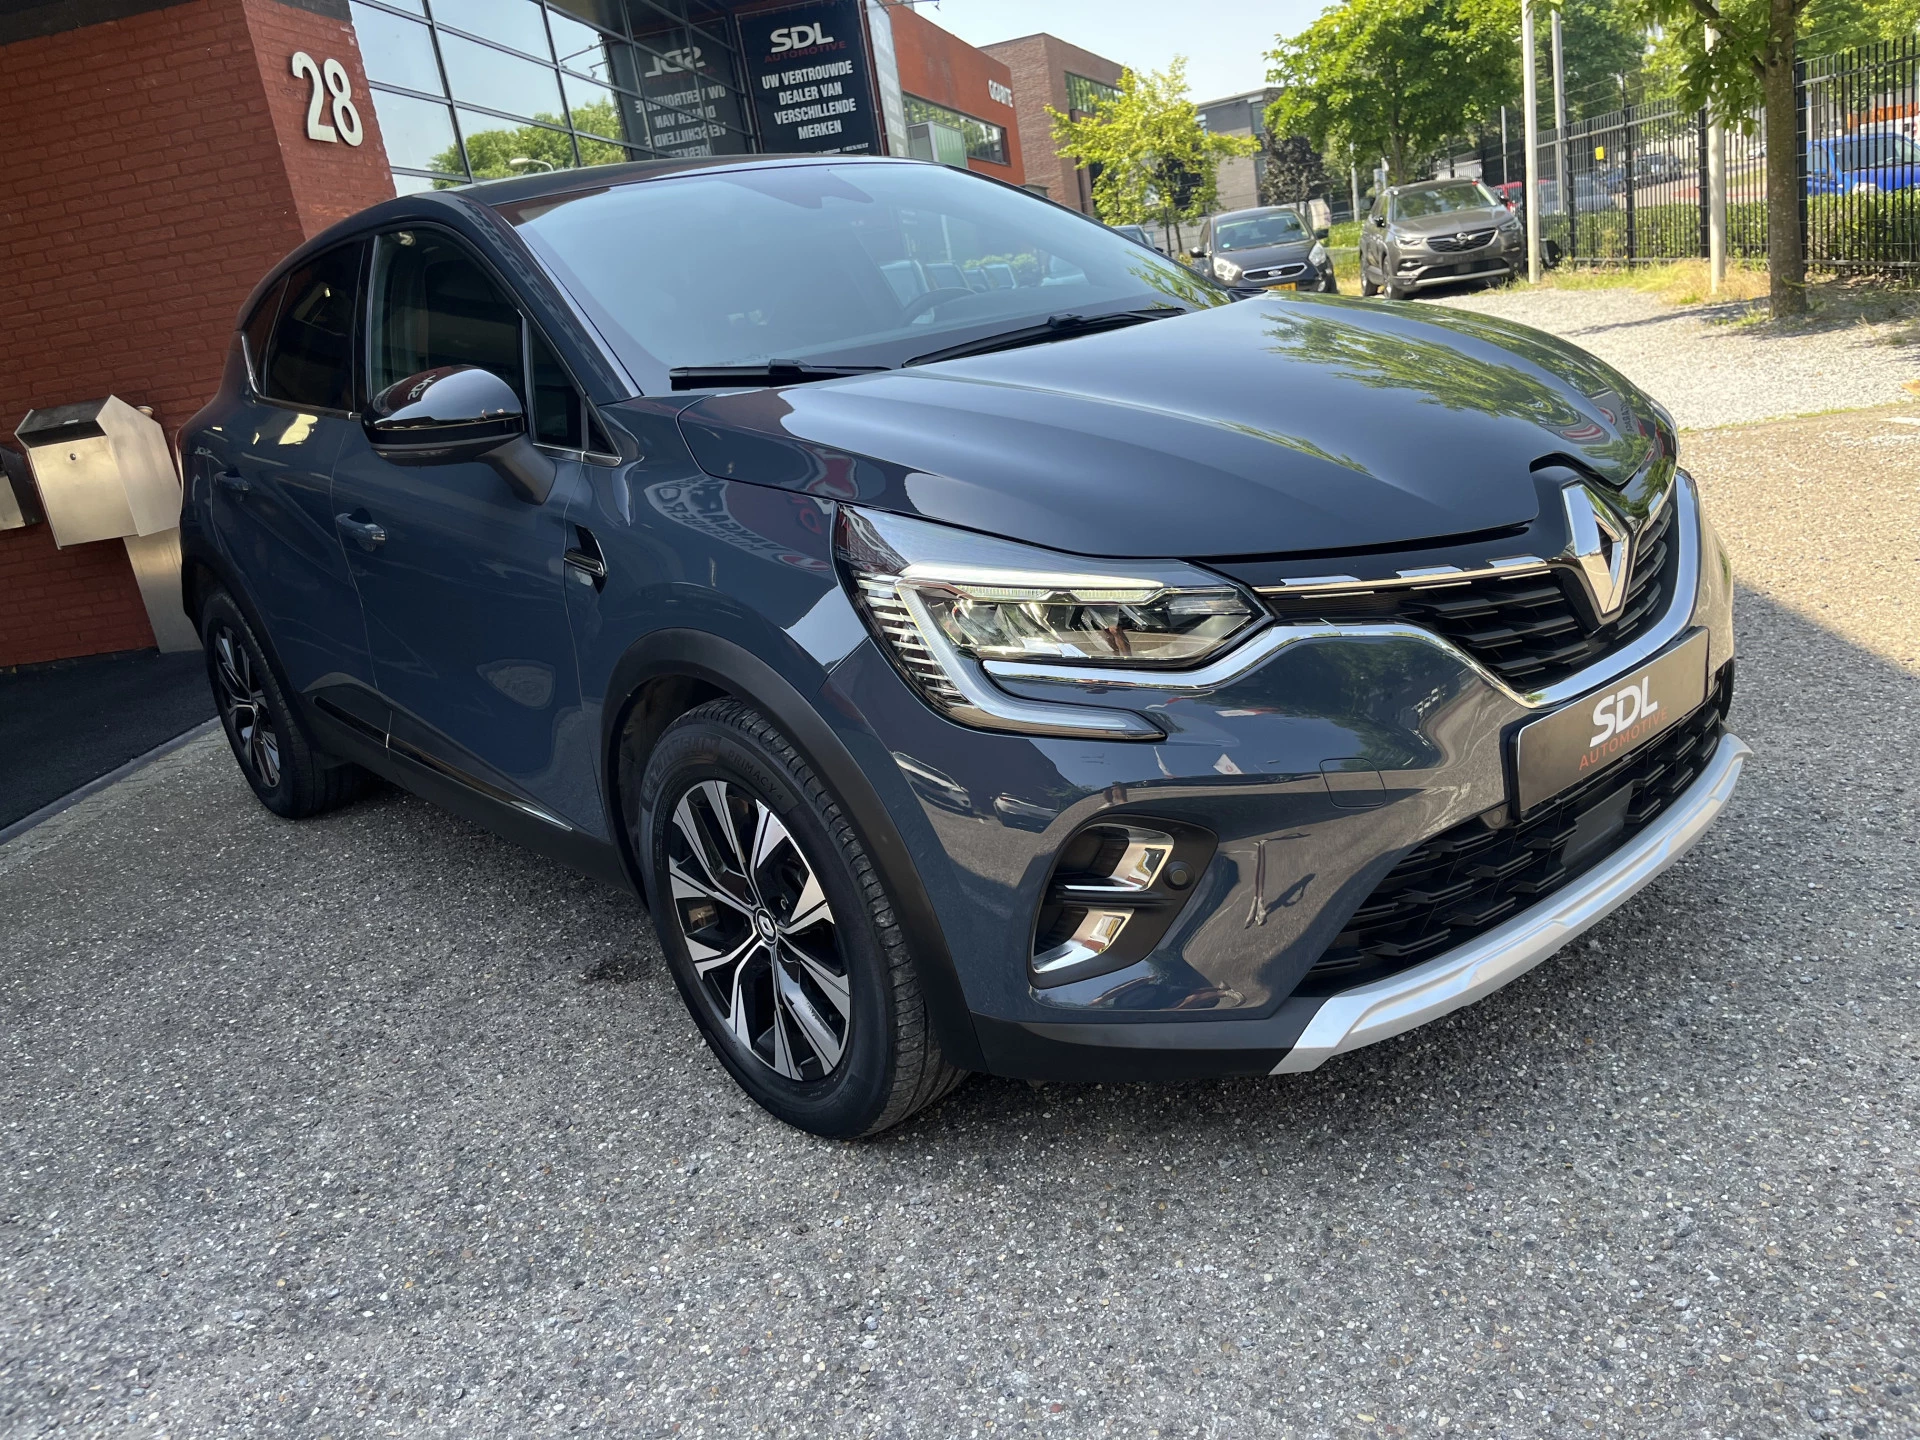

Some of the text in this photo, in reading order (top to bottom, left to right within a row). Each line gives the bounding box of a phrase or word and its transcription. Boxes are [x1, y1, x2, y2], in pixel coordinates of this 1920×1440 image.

[763, 41, 847, 63] AUTOMOTIVE
[769, 22, 835, 53] SDL
[761, 60, 854, 89] UW VERTROUWDE
[291, 51, 364, 147] 28
[778, 81, 843, 106] DEALER VAN
[773, 98, 857, 125] VERSCHILLENDE
[797, 120, 843, 140] MERKEN
[1589, 675, 1658, 748] SDL
[1578, 706, 1669, 771] AUTOMOTIVE
[727, 749, 777, 793] PRIMACY
